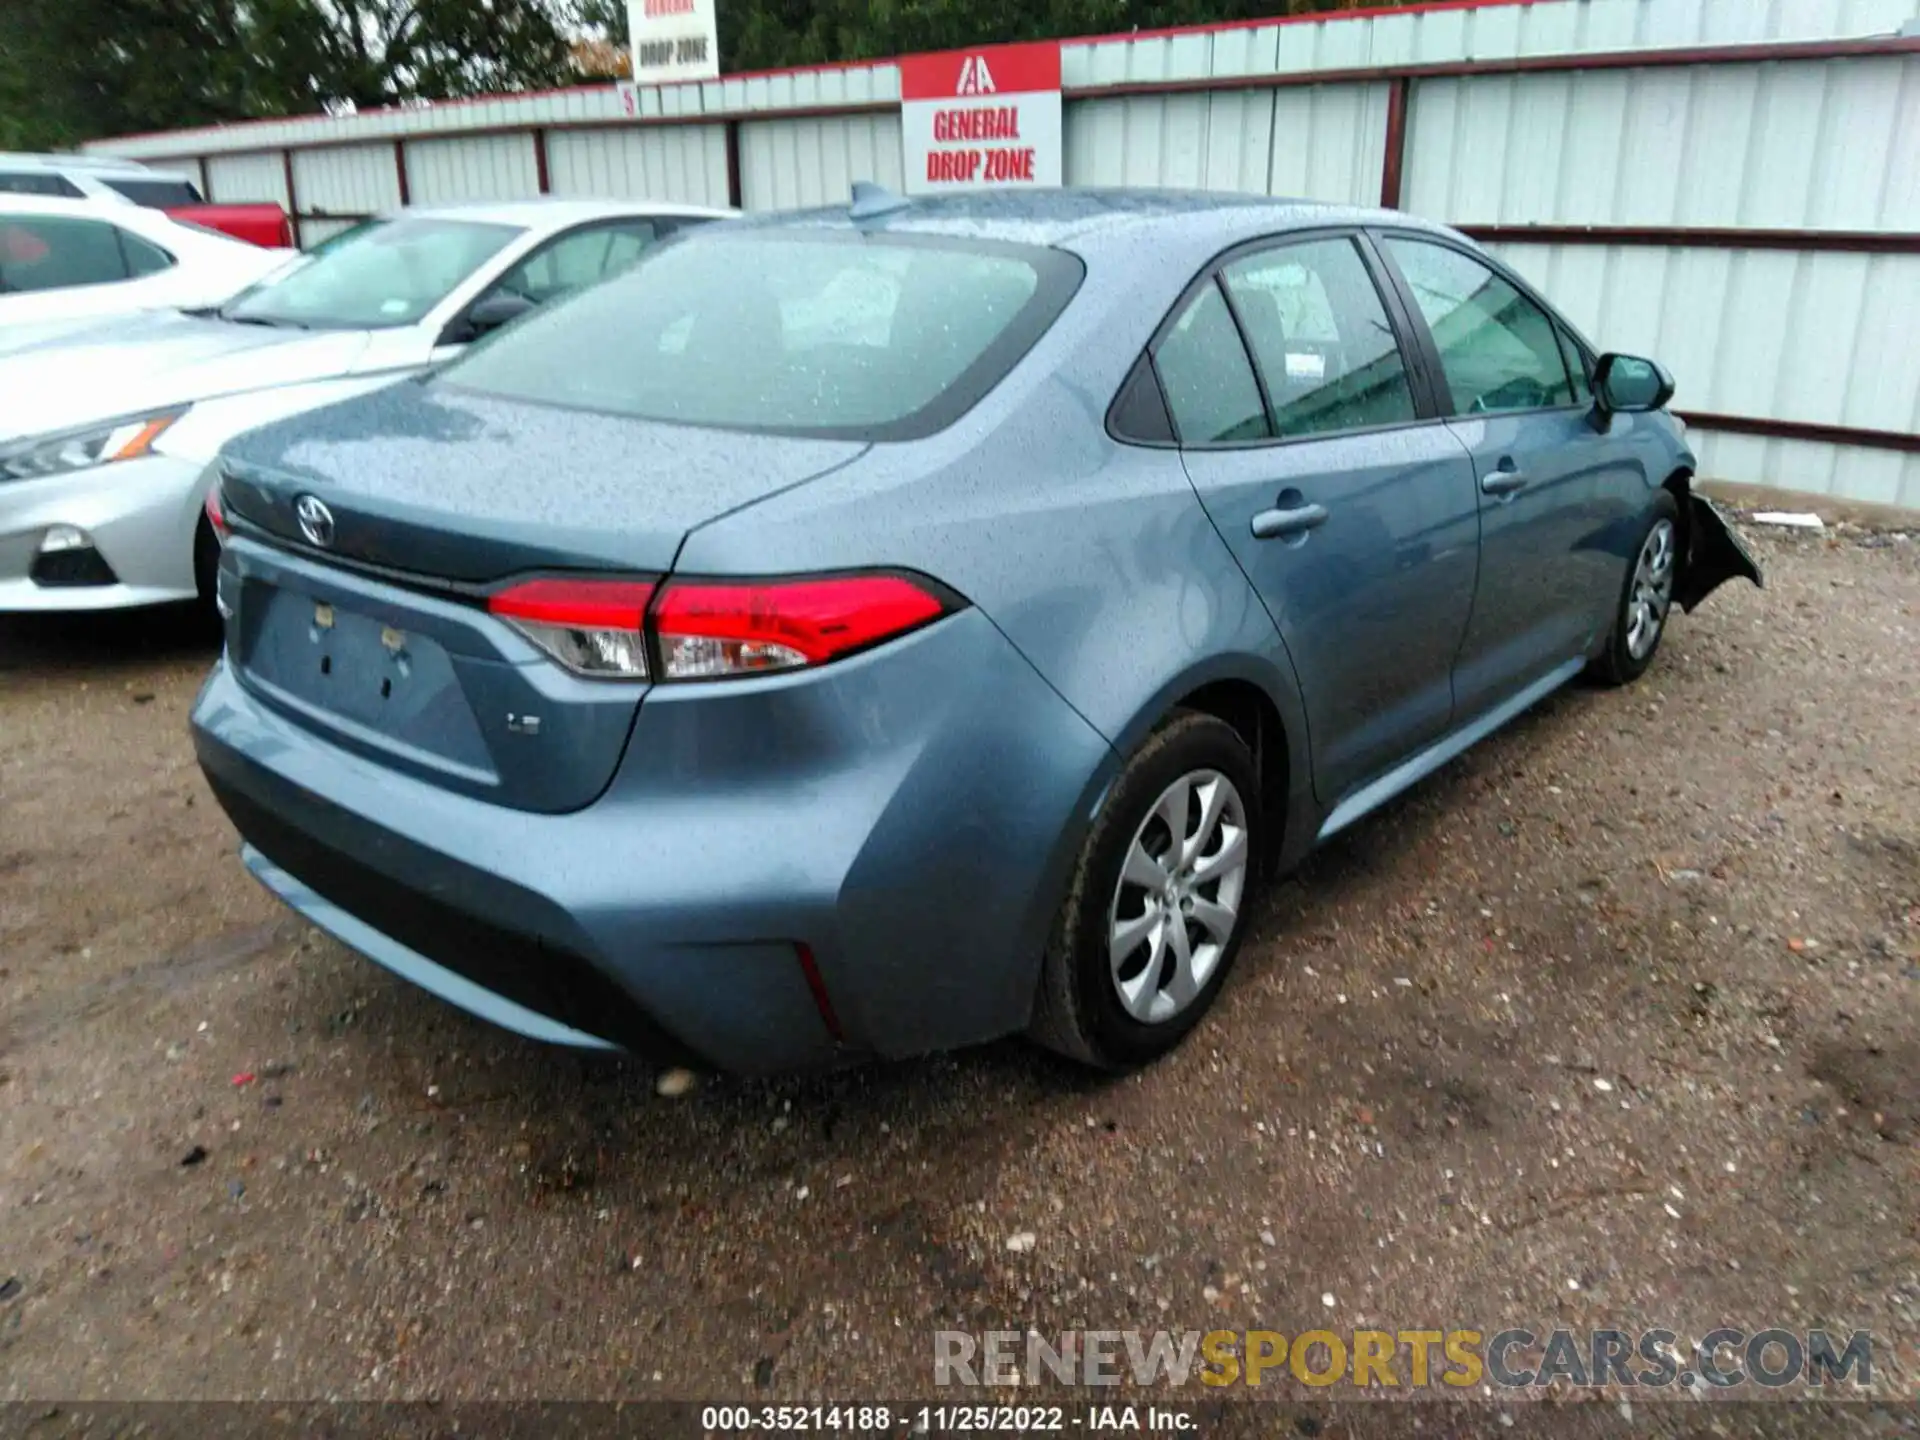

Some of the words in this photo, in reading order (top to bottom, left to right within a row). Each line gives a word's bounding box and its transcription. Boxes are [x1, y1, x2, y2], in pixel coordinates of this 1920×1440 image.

[640, 40, 673, 66] DROP
[677, 36, 708, 64] ZONE
[933, 106, 1020, 142] GENERAL
[926, 151, 981, 182] DROP
[983, 148, 1035, 181] ZONE
